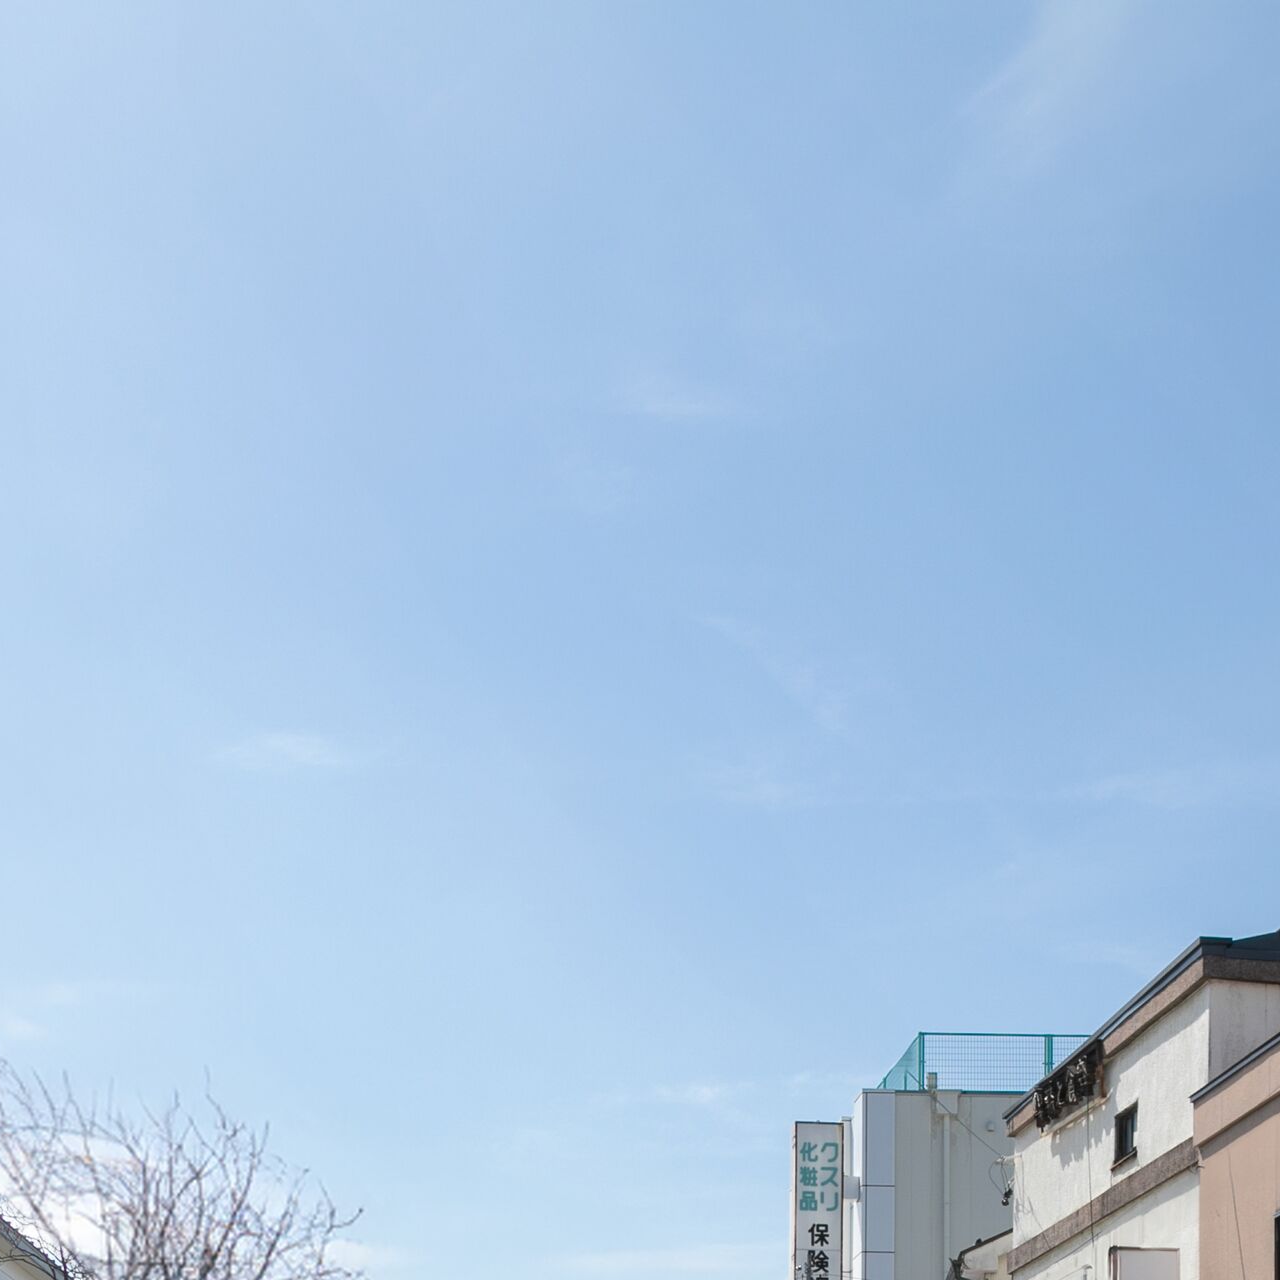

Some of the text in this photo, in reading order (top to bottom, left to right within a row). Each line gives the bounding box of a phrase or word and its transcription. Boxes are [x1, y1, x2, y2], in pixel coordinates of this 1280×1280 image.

[799, 1141, 819, 1212] 化粧品
[820, 1142, 839, 1212] クスリ
